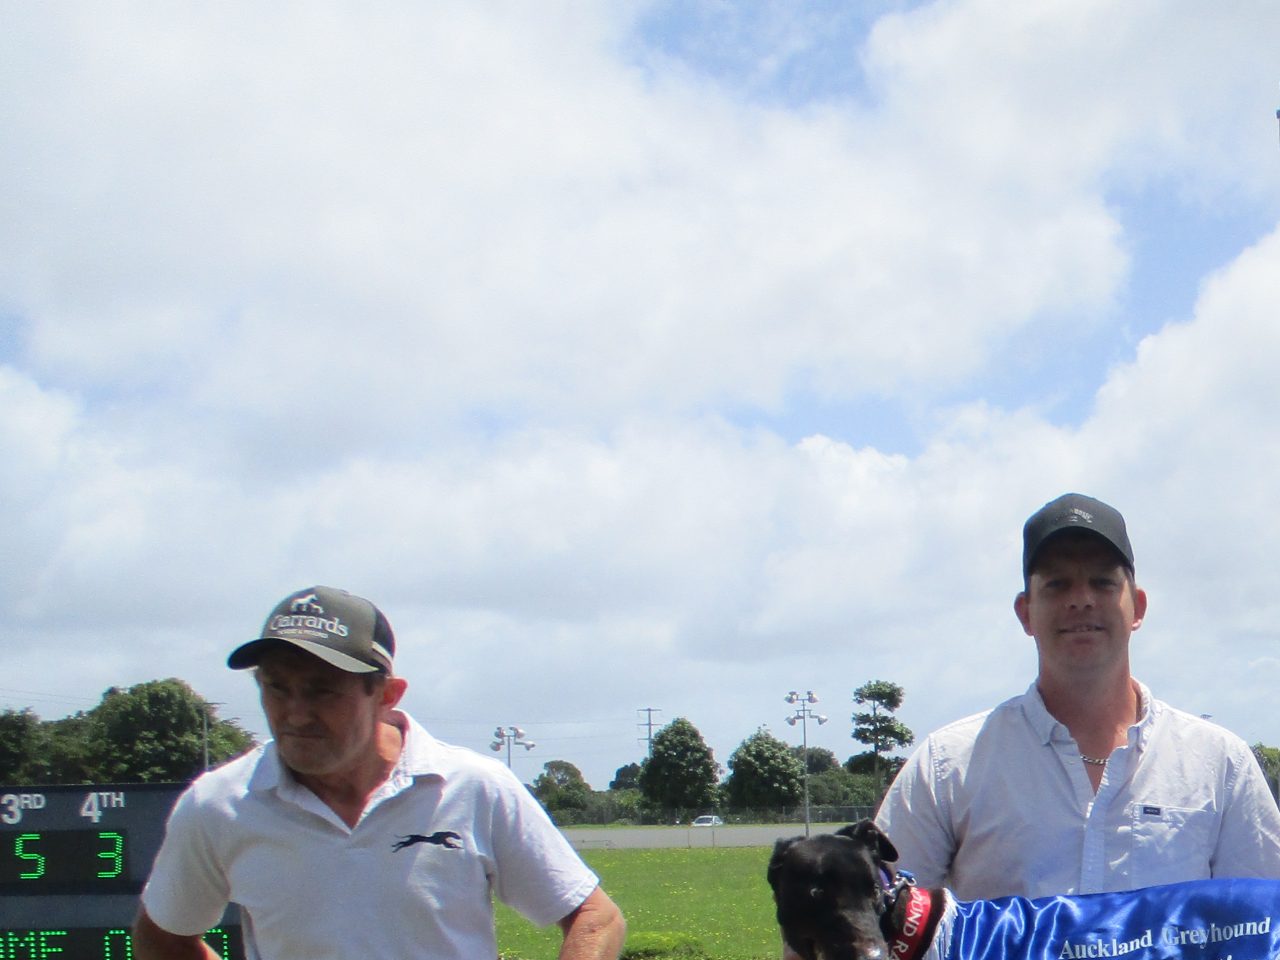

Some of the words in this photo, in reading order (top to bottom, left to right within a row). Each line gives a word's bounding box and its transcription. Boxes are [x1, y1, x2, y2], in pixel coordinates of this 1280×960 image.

[1, 793, 46, 825] 3RD
[79, 791, 125, 823] 4TH
[97, 832, 123, 878] 3
[1058, 929, 1153, 960] Auckland
[1161, 917, 1271, 949] Greyhound
